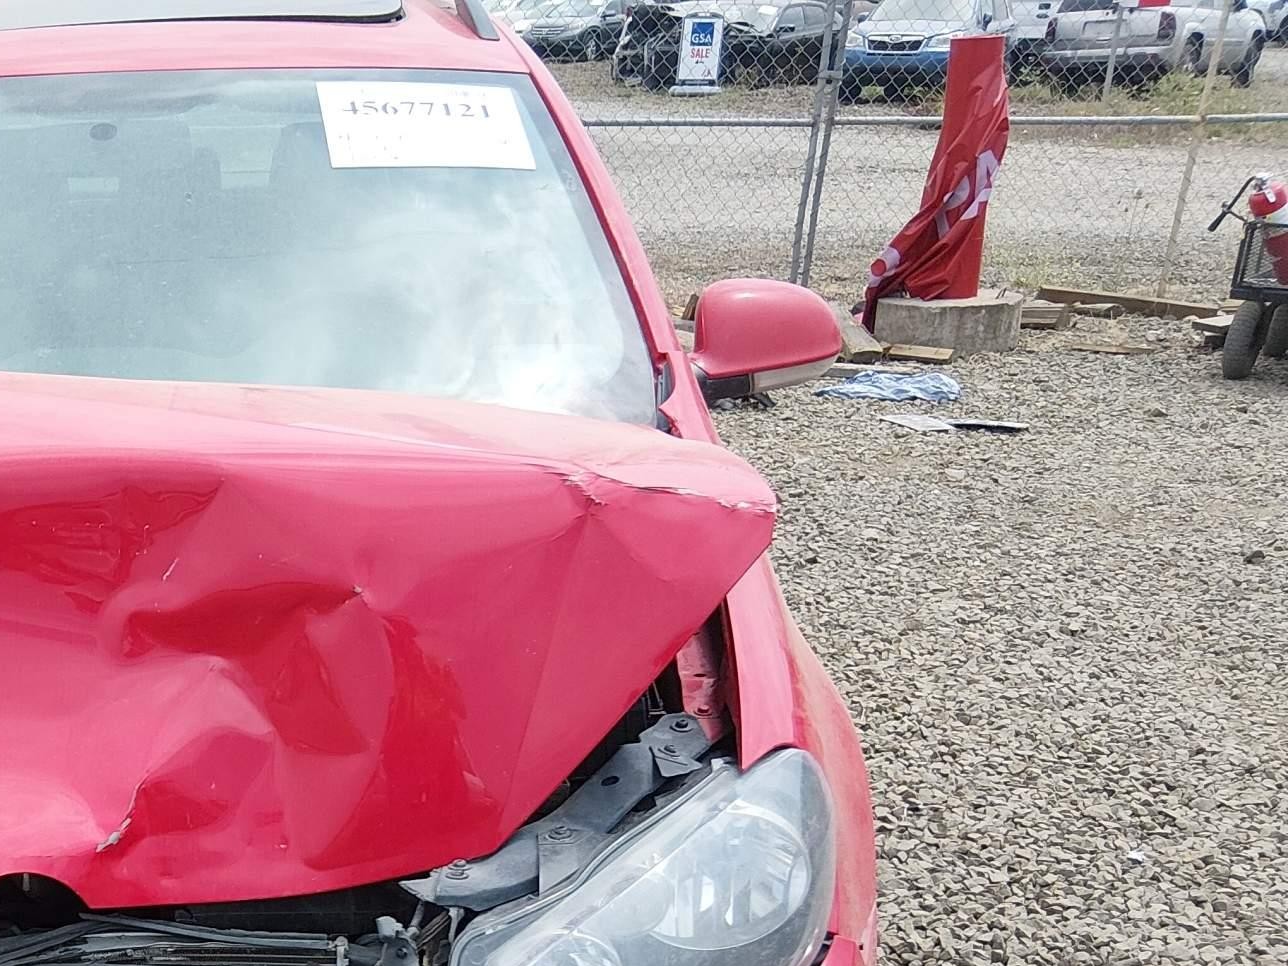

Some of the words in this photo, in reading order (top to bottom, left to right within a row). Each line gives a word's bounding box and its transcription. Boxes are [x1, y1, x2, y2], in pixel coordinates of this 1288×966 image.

[692, 33, 712, 44] GSA
[690, 48, 710, 58] SALE
[343, 101, 491, 118] 45677121
